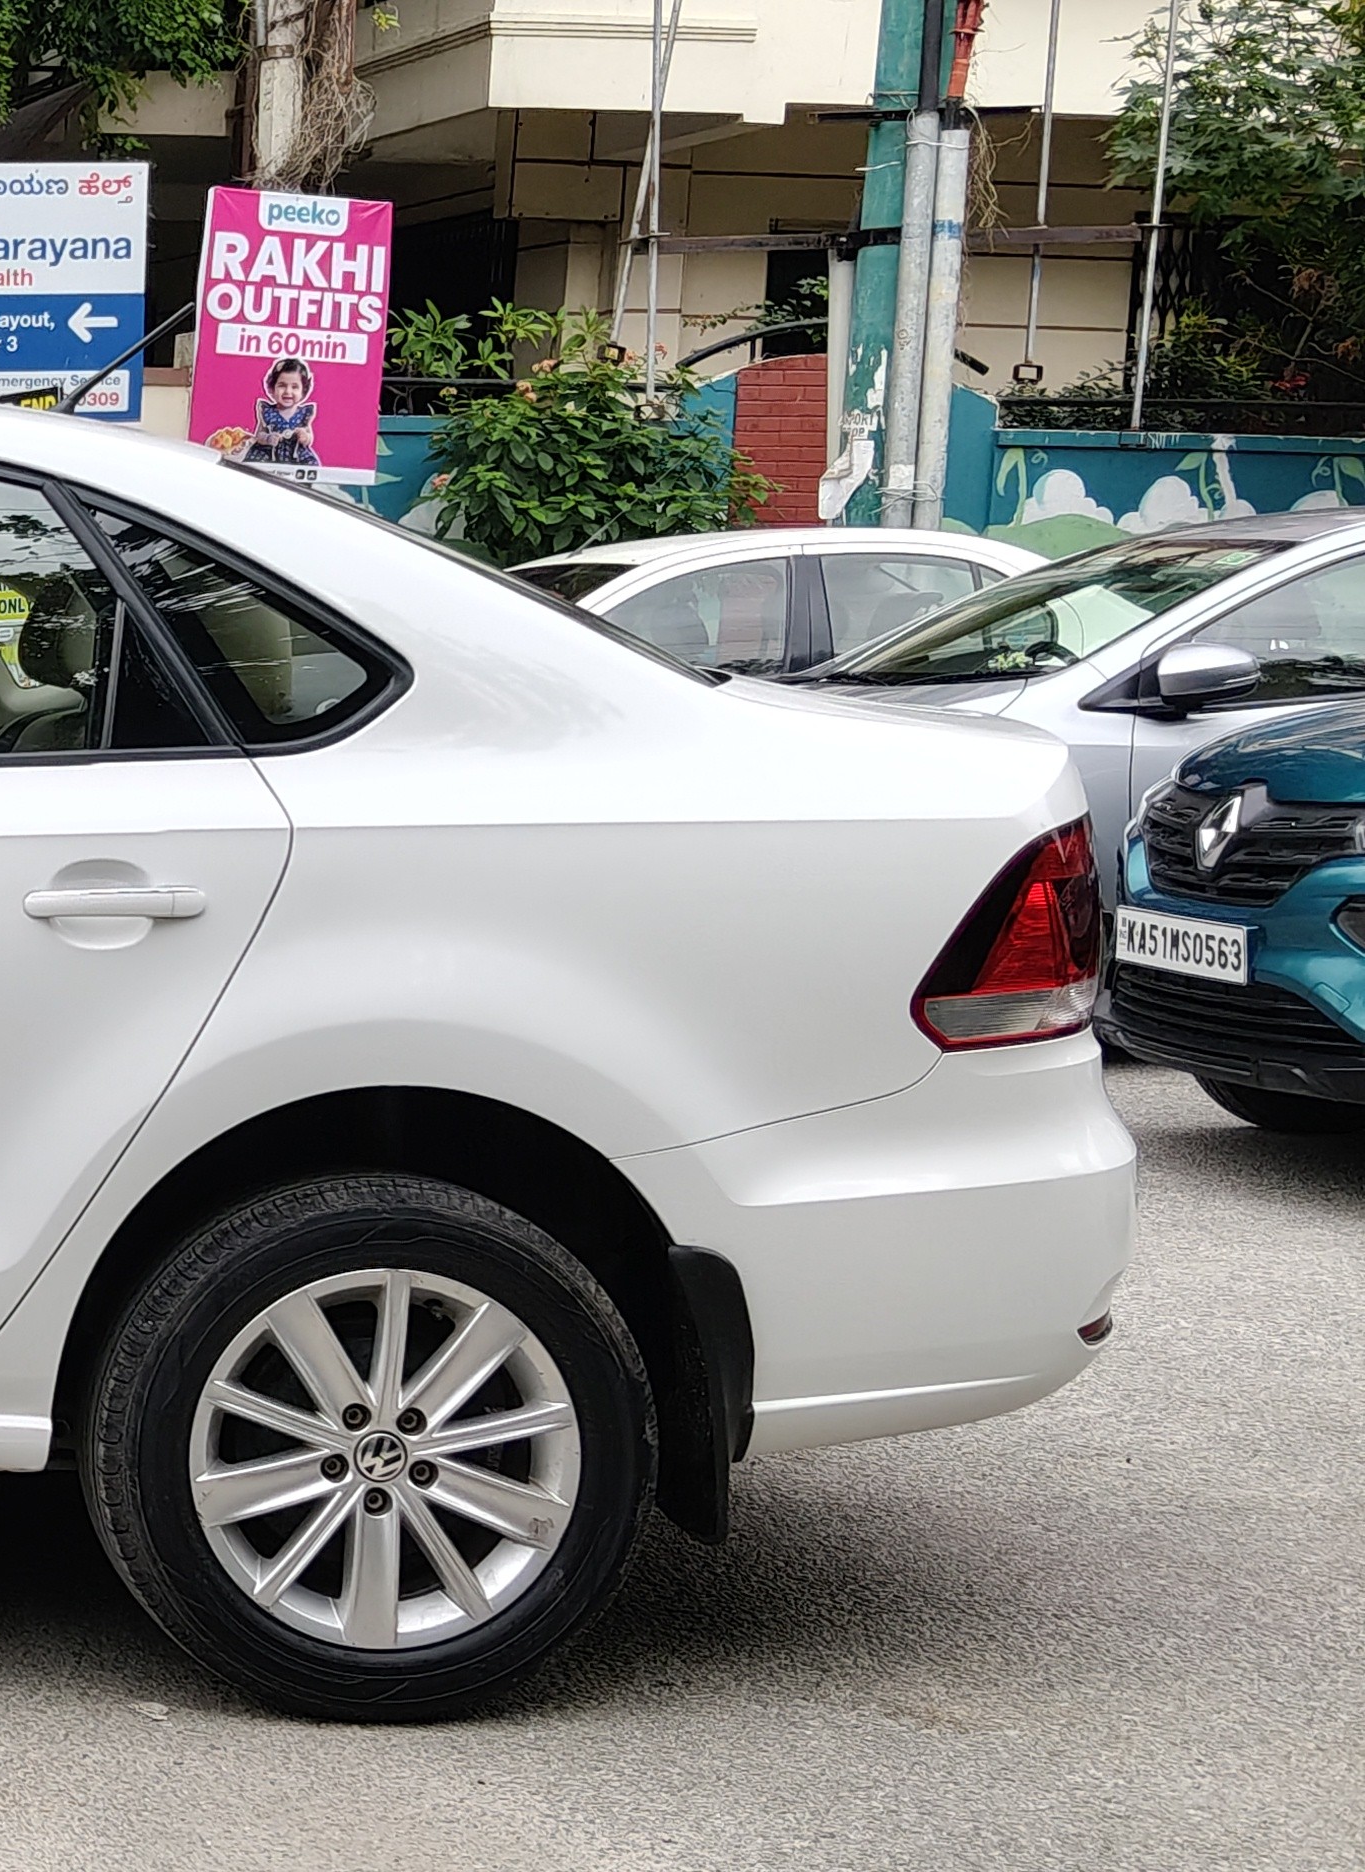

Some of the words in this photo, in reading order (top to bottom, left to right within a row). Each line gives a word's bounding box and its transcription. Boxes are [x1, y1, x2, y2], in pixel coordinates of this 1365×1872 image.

[267, 201, 340, 226] peeko
[210, 231, 386, 293] RAKHI
[206, 283, 383, 332] OUTFITS
[6, 336, 18, 352] 3
[239, 327, 261, 353] in
[267, 331, 347, 360] 60min
[1127, 919, 1242, 972] KA51MS0563
